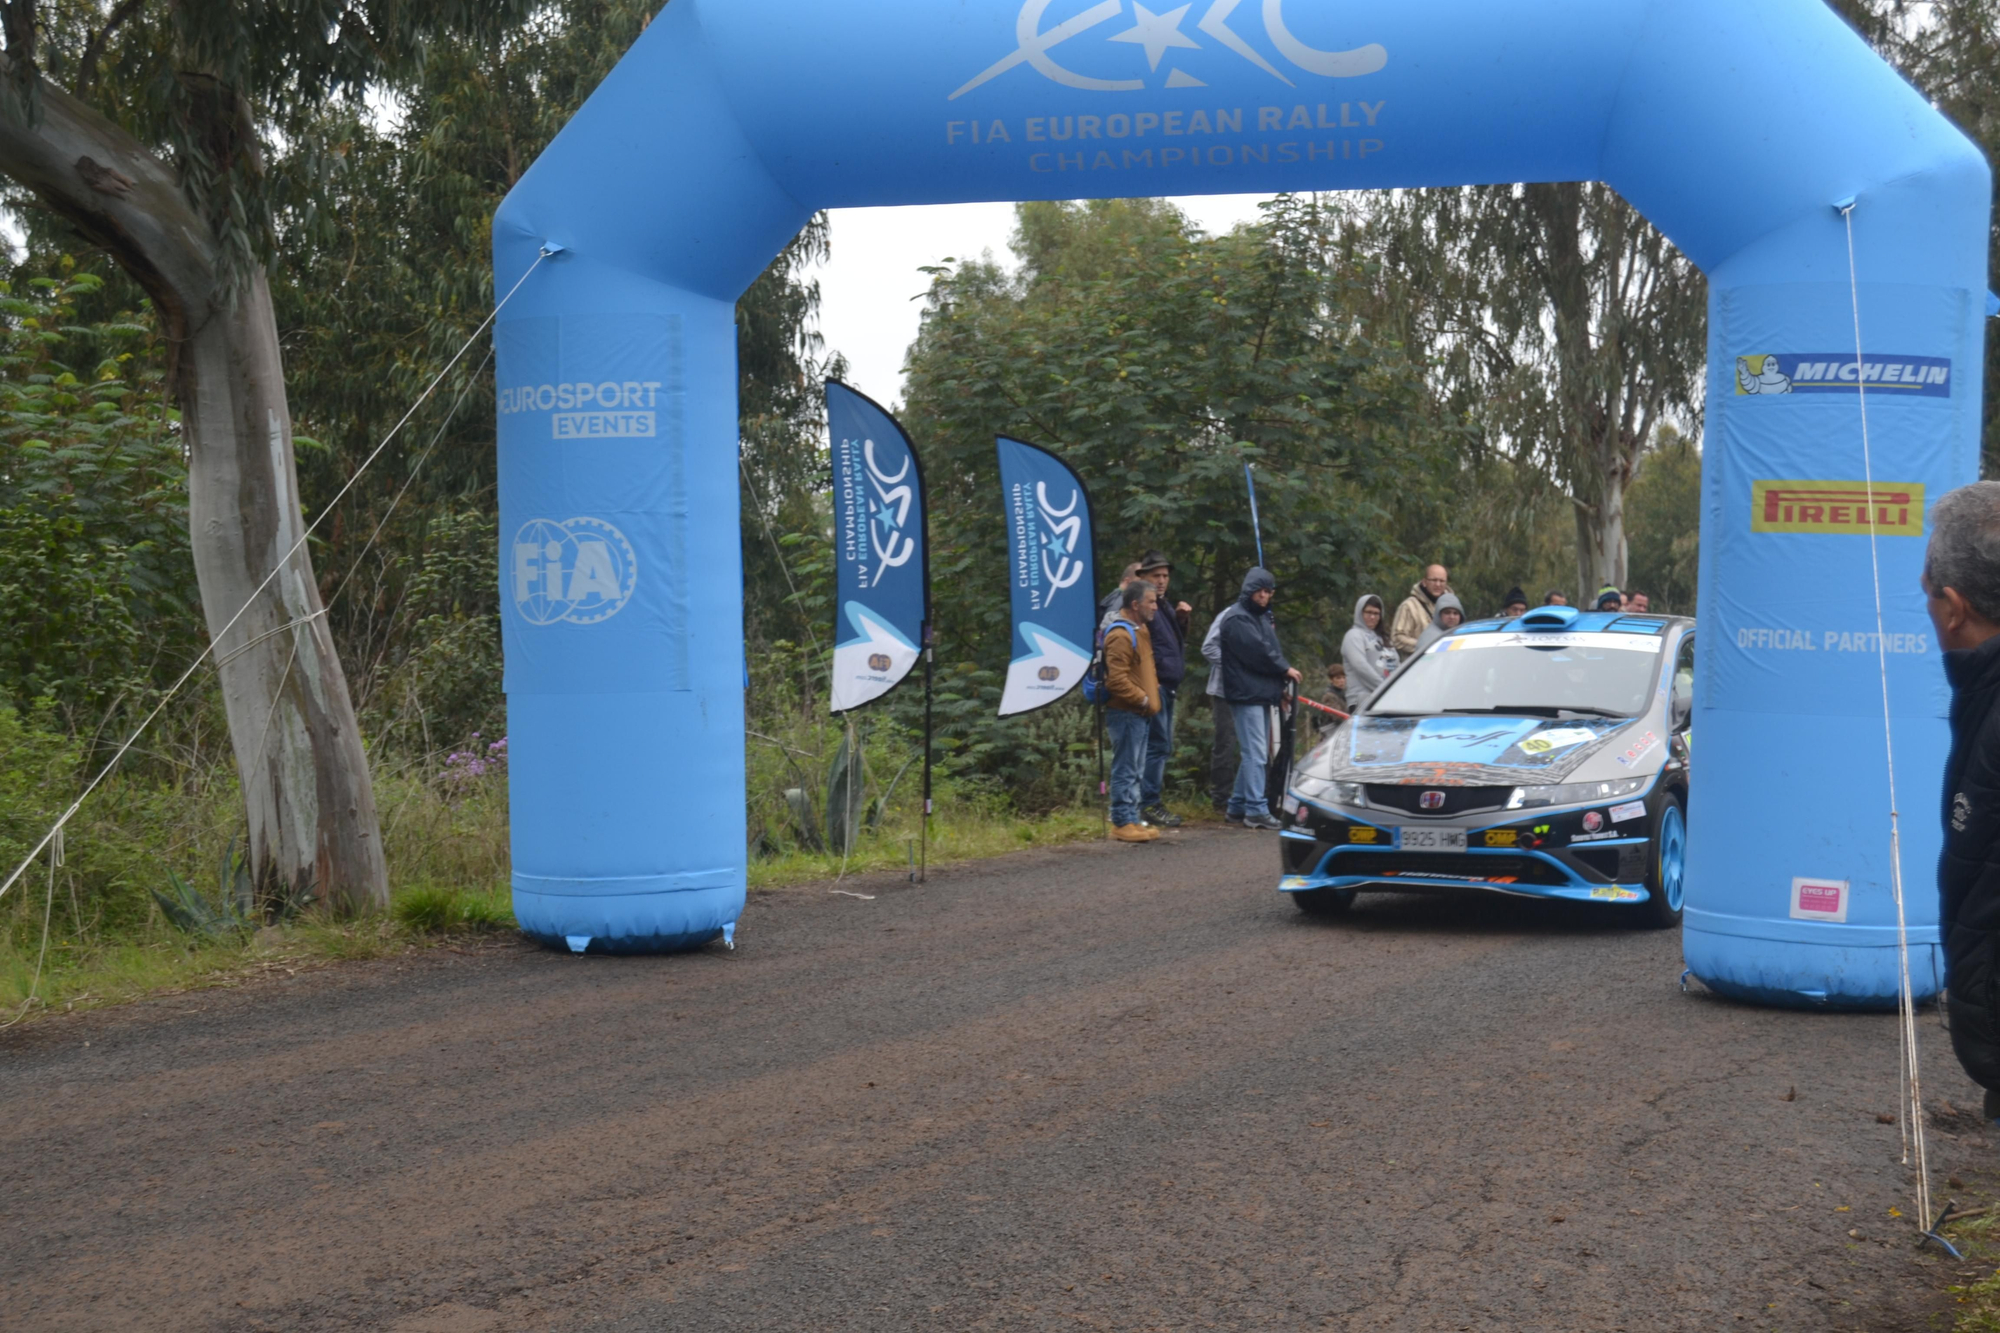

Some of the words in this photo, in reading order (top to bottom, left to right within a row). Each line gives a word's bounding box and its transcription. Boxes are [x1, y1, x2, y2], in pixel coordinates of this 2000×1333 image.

[946, 119, 1011, 145] FIA
[1026, 108, 1243, 142] EUROPEAN
[1258, 101, 1386, 132] RALLY
[1029, 138, 1385, 172] CHAMPIONSHIP
[1794, 362, 1949, 385] MICHELIN
[500, 381, 662, 414] EUROSPORT
[557, 415, 650, 436] EVENTS
[1764, 489, 1911, 526] PIRELLI
[1737, 628, 1816, 651] OFFICIAL
[1824, 630, 1928, 654] PARTNERS
[1526, 739, 1551, 751] 40
[1348, 829, 1378, 842] OMP
[1402, 831, 1437, 847] 9925
[1484, 832, 1518, 845] OMP
